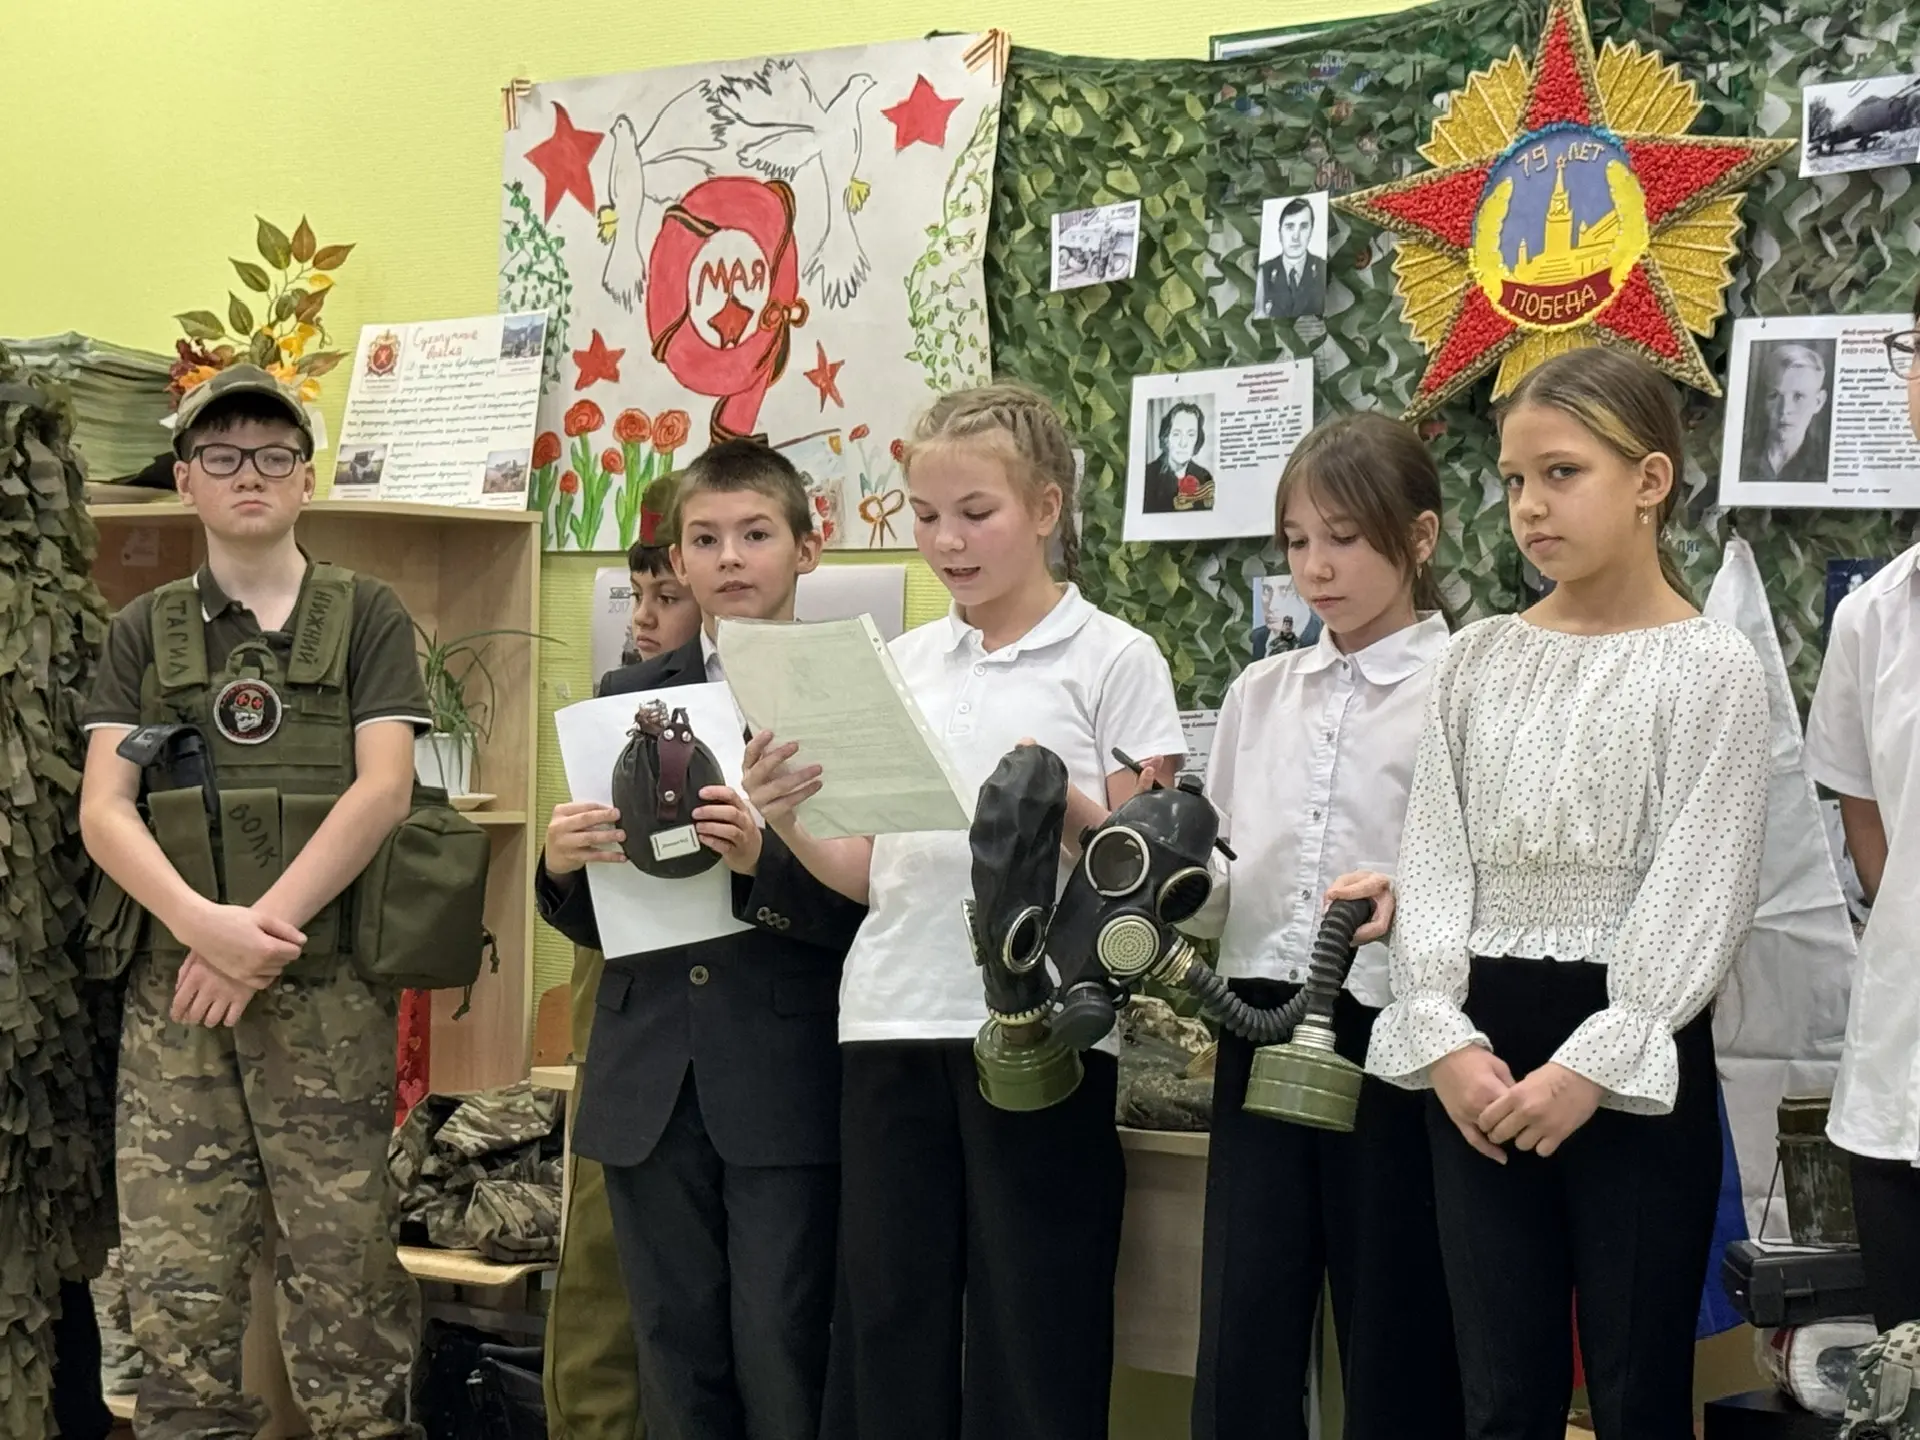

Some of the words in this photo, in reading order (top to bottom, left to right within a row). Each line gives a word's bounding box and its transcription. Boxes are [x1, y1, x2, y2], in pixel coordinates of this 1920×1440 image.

[1568, 142, 1605, 161] ЛЕТ
[695, 257, 766, 306] МАЯ
[1511, 283, 1597, 320] ПОБЕДА
[296, 590, 334, 666] НИЖНИЙ
[608, 601, 630, 613] 2017
[166, 600, 190, 679] ТАГИЛ
[228, 803, 278, 868] ВОЛК
